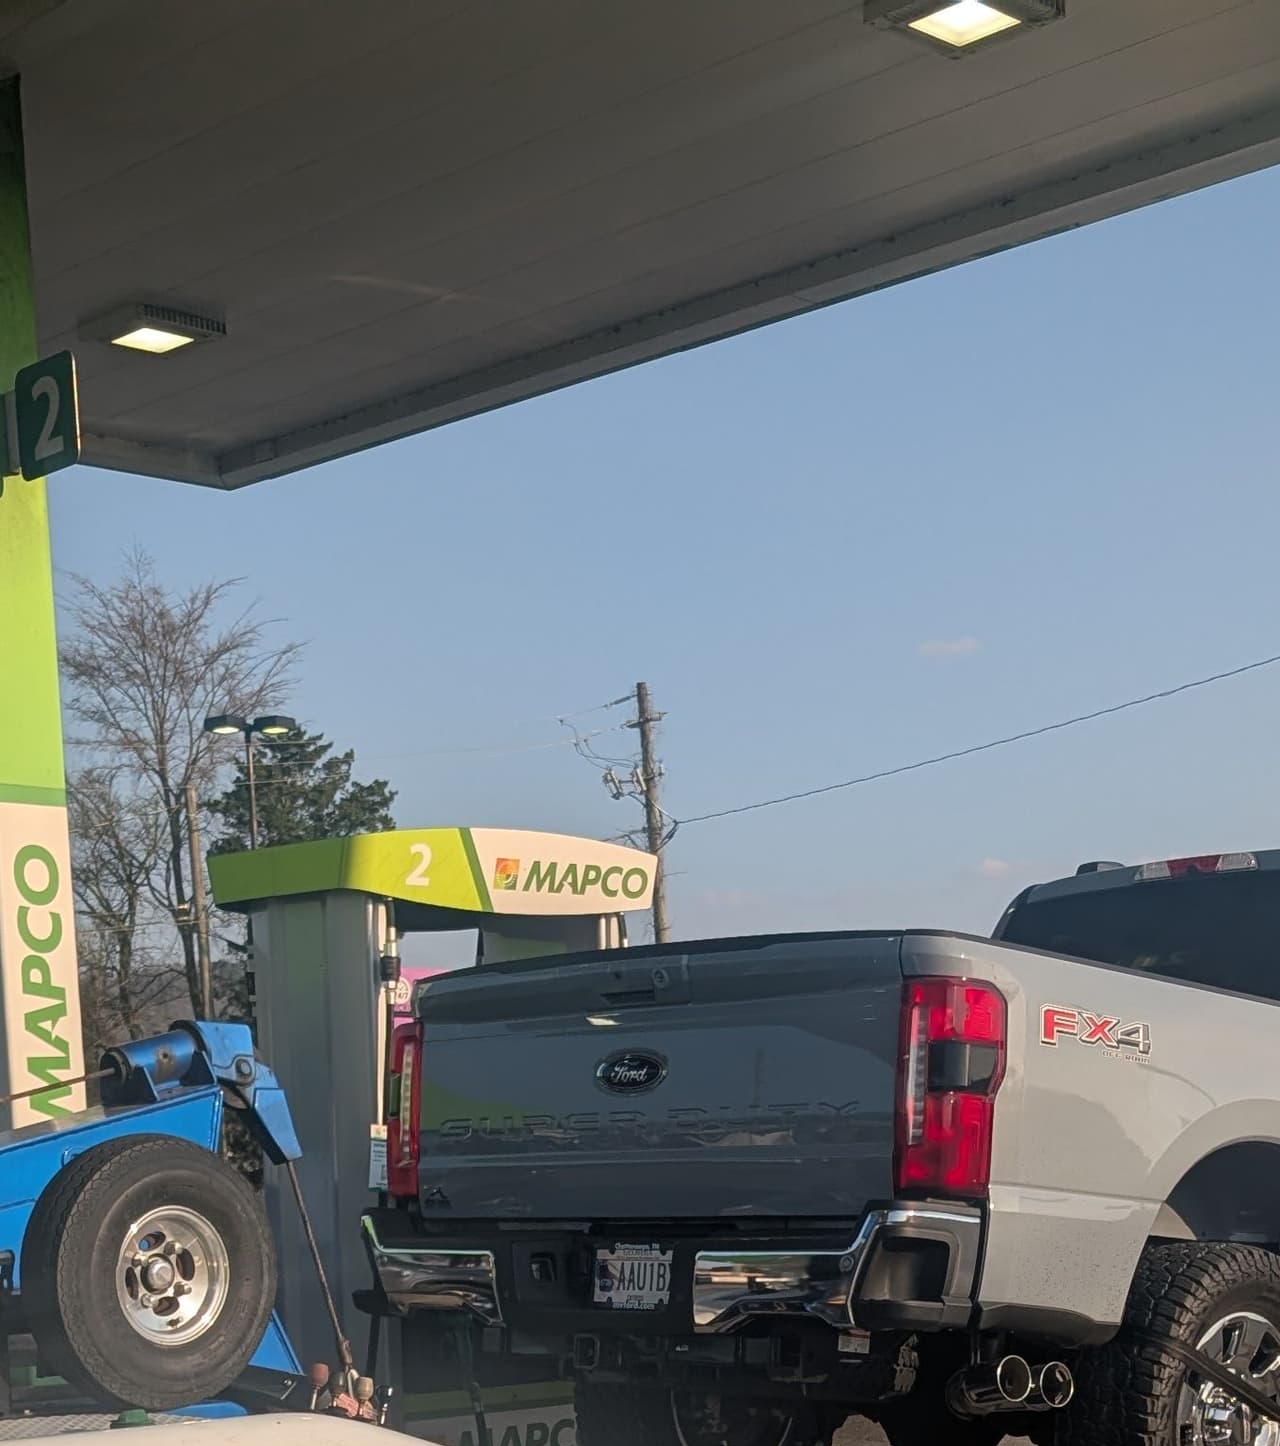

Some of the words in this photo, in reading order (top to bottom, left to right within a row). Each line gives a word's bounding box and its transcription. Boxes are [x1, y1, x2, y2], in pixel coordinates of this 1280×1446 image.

[31, 375, 65, 461] 2
[405, 843, 433, 887] 2
[521, 860, 649, 900] MAPCO
[13, 844, 75, 1121] MAPCO
[1040, 1003, 1152, 1056] FX4
[610, 1060, 649, 1083] Ford
[616, 1261, 670, 1292] AAU1B
